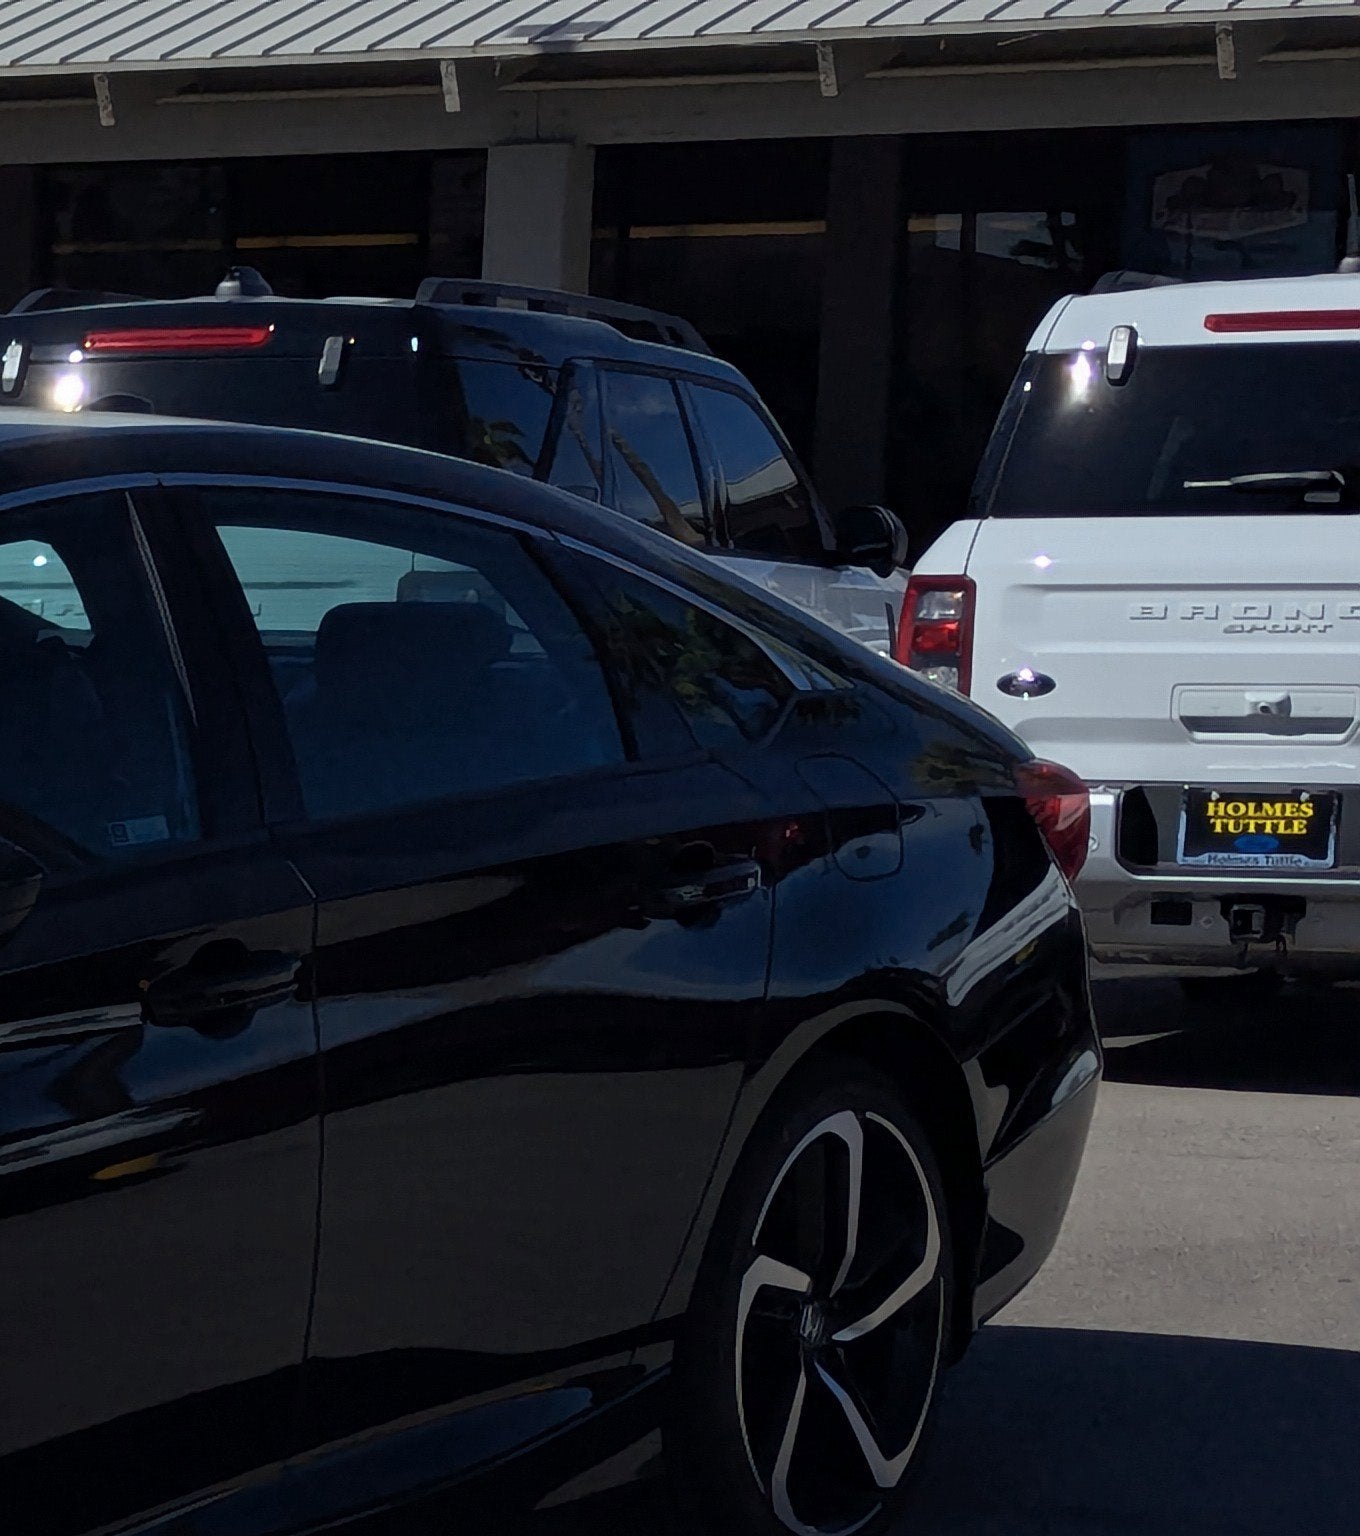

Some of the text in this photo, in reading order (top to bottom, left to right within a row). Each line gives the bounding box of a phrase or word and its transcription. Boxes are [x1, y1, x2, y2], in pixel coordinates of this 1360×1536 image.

[1223, 624, 1334, 634] SPORT
[1206, 802, 1314, 818] HOLMES
[1210, 819, 1308, 835] TUTTLE
